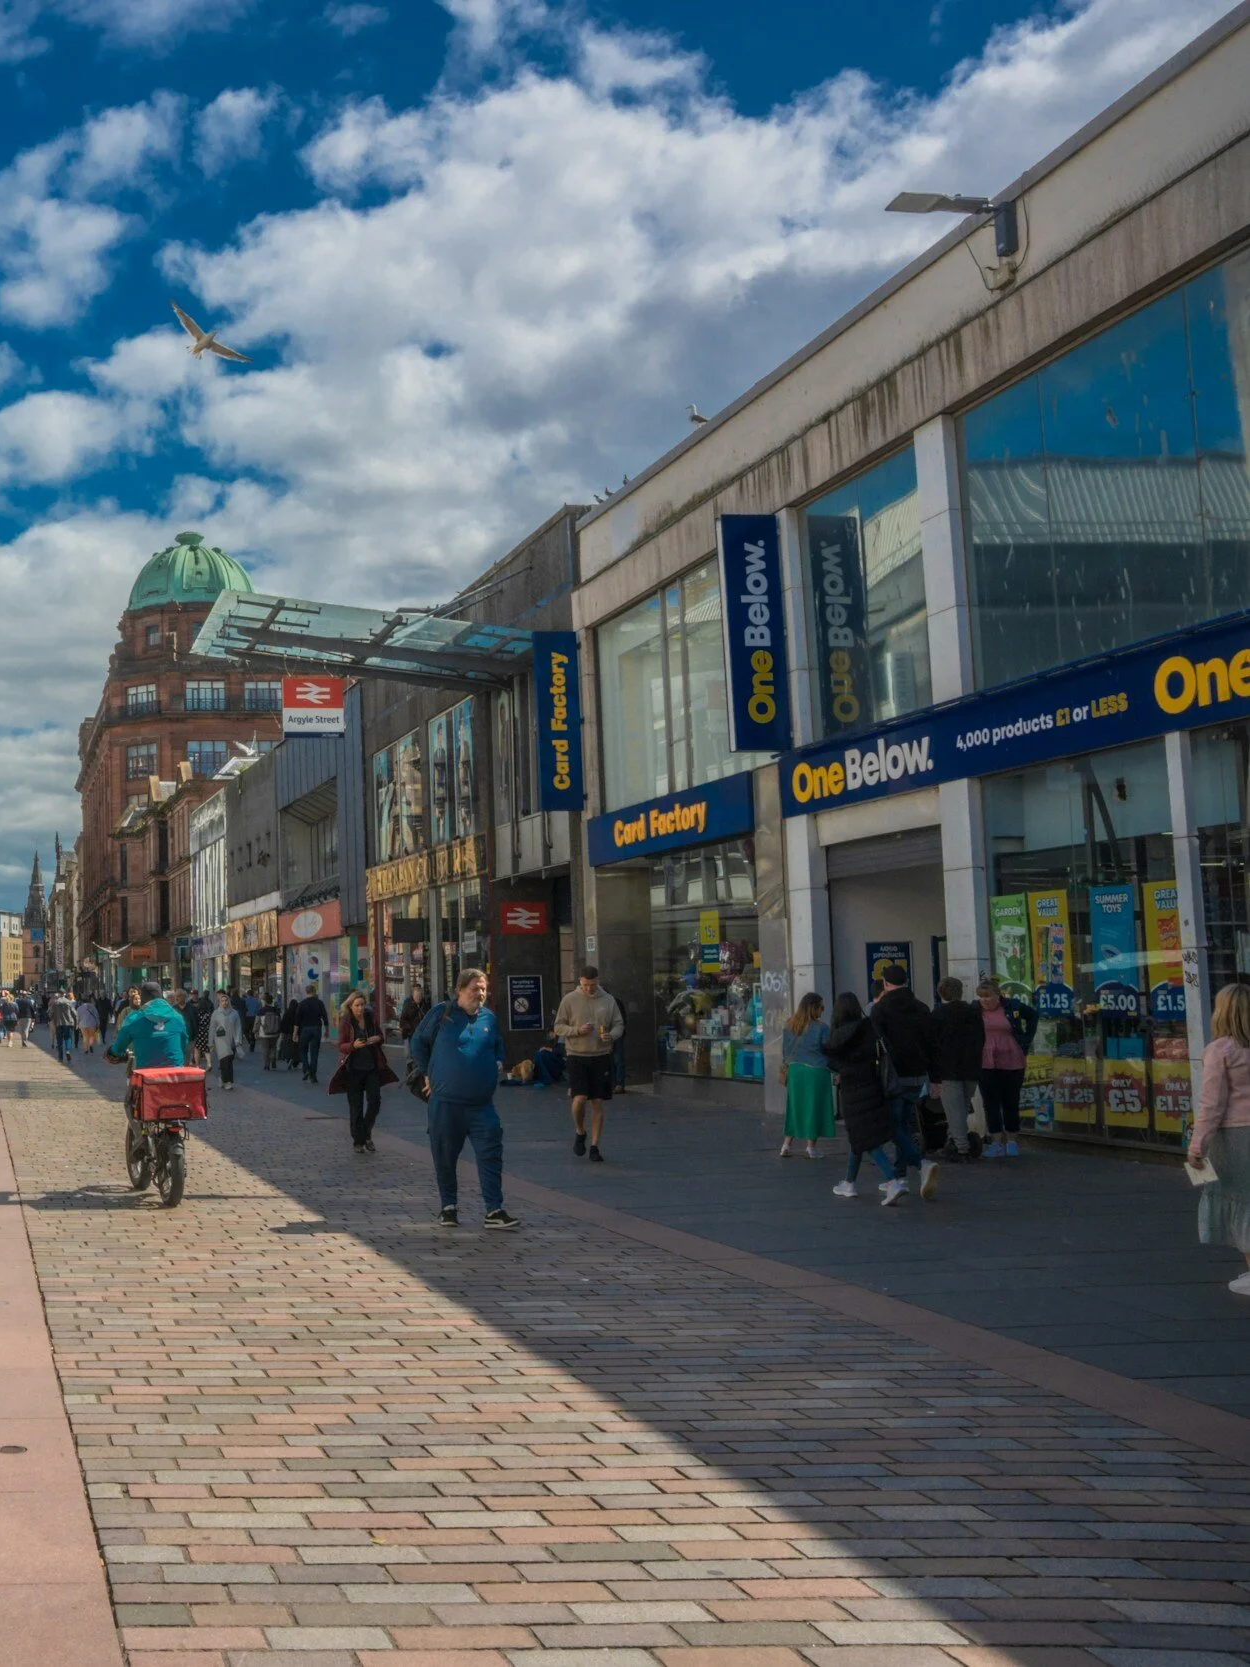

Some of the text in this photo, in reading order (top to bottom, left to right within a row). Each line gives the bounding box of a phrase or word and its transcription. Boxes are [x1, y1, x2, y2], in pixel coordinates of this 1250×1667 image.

[748, 650, 776, 724] One
[1154, 649, 1250, 715] One
[288, 715, 340, 725] Argyle Street
[549, 652, 571, 790] Card Factory
[956, 692, 1128, 751] 4,000 products £1 or LESS
[614, 801, 707, 847] Card Factory
[1095, 893, 1128, 904] SUMMER
[1154, 889, 1177, 900] GREA
[1036, 898, 1058, 908] GREAT
[1102, 903, 1122, 913] TOYS
[1155, 899, 1177, 910] VALU
[995, 906, 1021, 917] GARDEN
[1037, 907, 1058, 917] VALUE
[1039, 994, 1069, 1009] £1.25
[1100, 994, 1137, 1011] £5.00
[1157, 995, 1185, 1011] £1.5
[1024, 1069, 1053, 1081] ALE
[1063, 1076, 1082, 1085] ONLY
[1111, 1079, 1133, 1088] ONLY
[1165, 1082, 1188, 1091] ONLY
[1056, 1088, 1095, 1103] £1.25
[1108, 1089, 1142, 1113] £5
